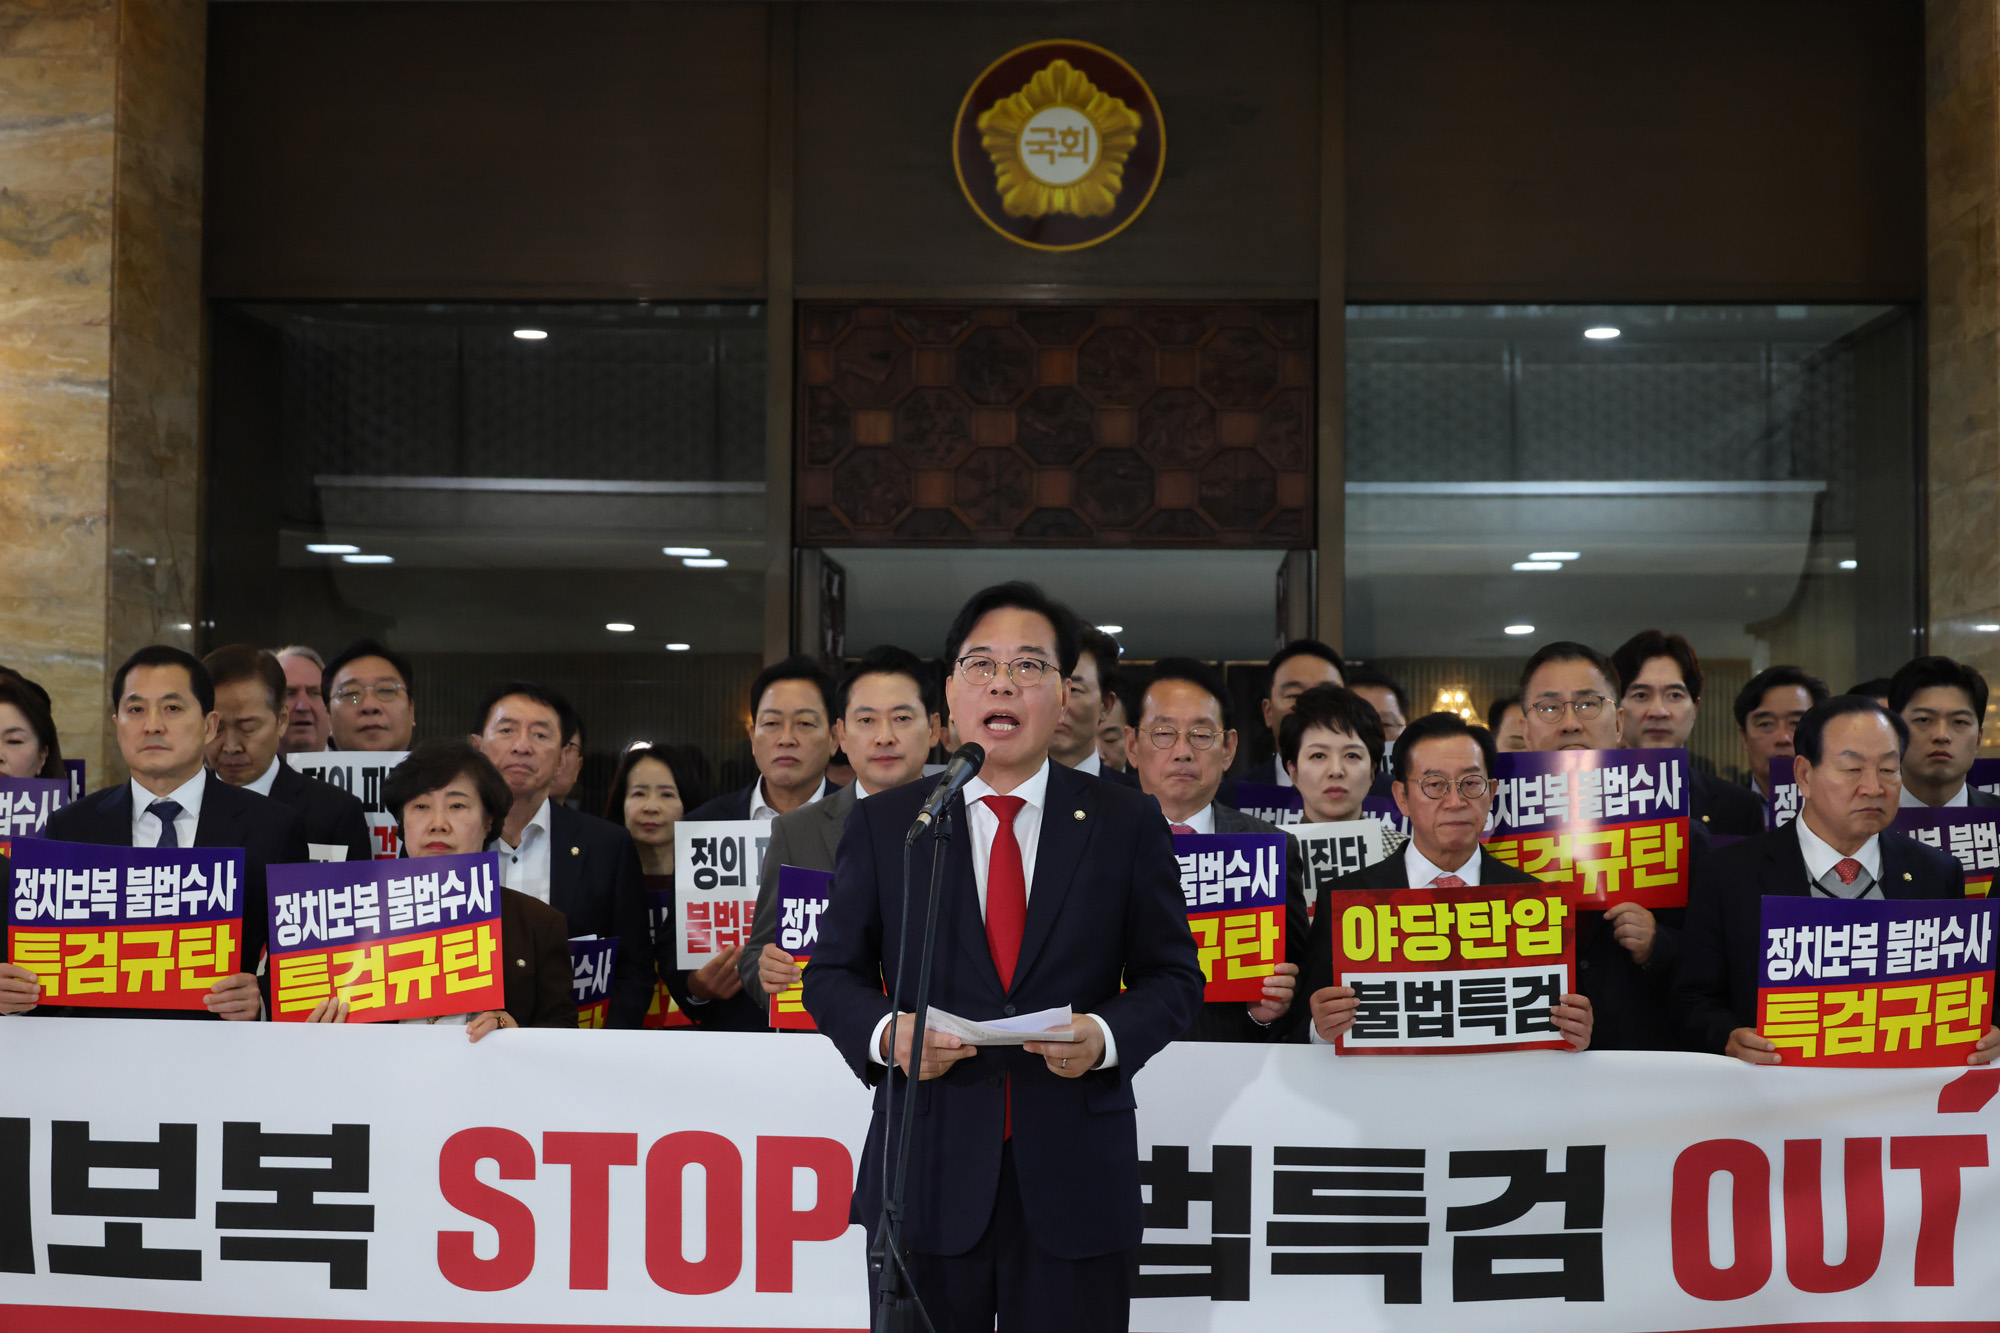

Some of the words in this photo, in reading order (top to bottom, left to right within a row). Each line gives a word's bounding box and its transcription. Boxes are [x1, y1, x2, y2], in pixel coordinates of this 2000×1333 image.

[1025, 126, 1089, 165] 국회
[1577, 760, 1682, 820] 불법수사
[15, 868, 117, 920] 정치보복
[126, 860, 237, 918] 불법수사
[691, 836, 746, 890] 정의
[275, 882, 381, 947] 정치보복
[387, 863, 493, 931] 불법수사
[1342, 897, 1568, 962] 야당탄압
[13, 924, 236, 996] 특검규탄
[278, 925, 497, 1013] 특검규탄
[571, 948, 612, 1000] 수사
[1767, 922, 1879, 981] 정치보복
[1886, 911, 1992, 975] 불법수사
[1350, 973, 1562, 1039] 불법특검
[1763, 976, 1989, 1058] 특검규탄
[436, 1127, 854, 1295] STOP
[1671, 1134, 1990, 1301] OUT
